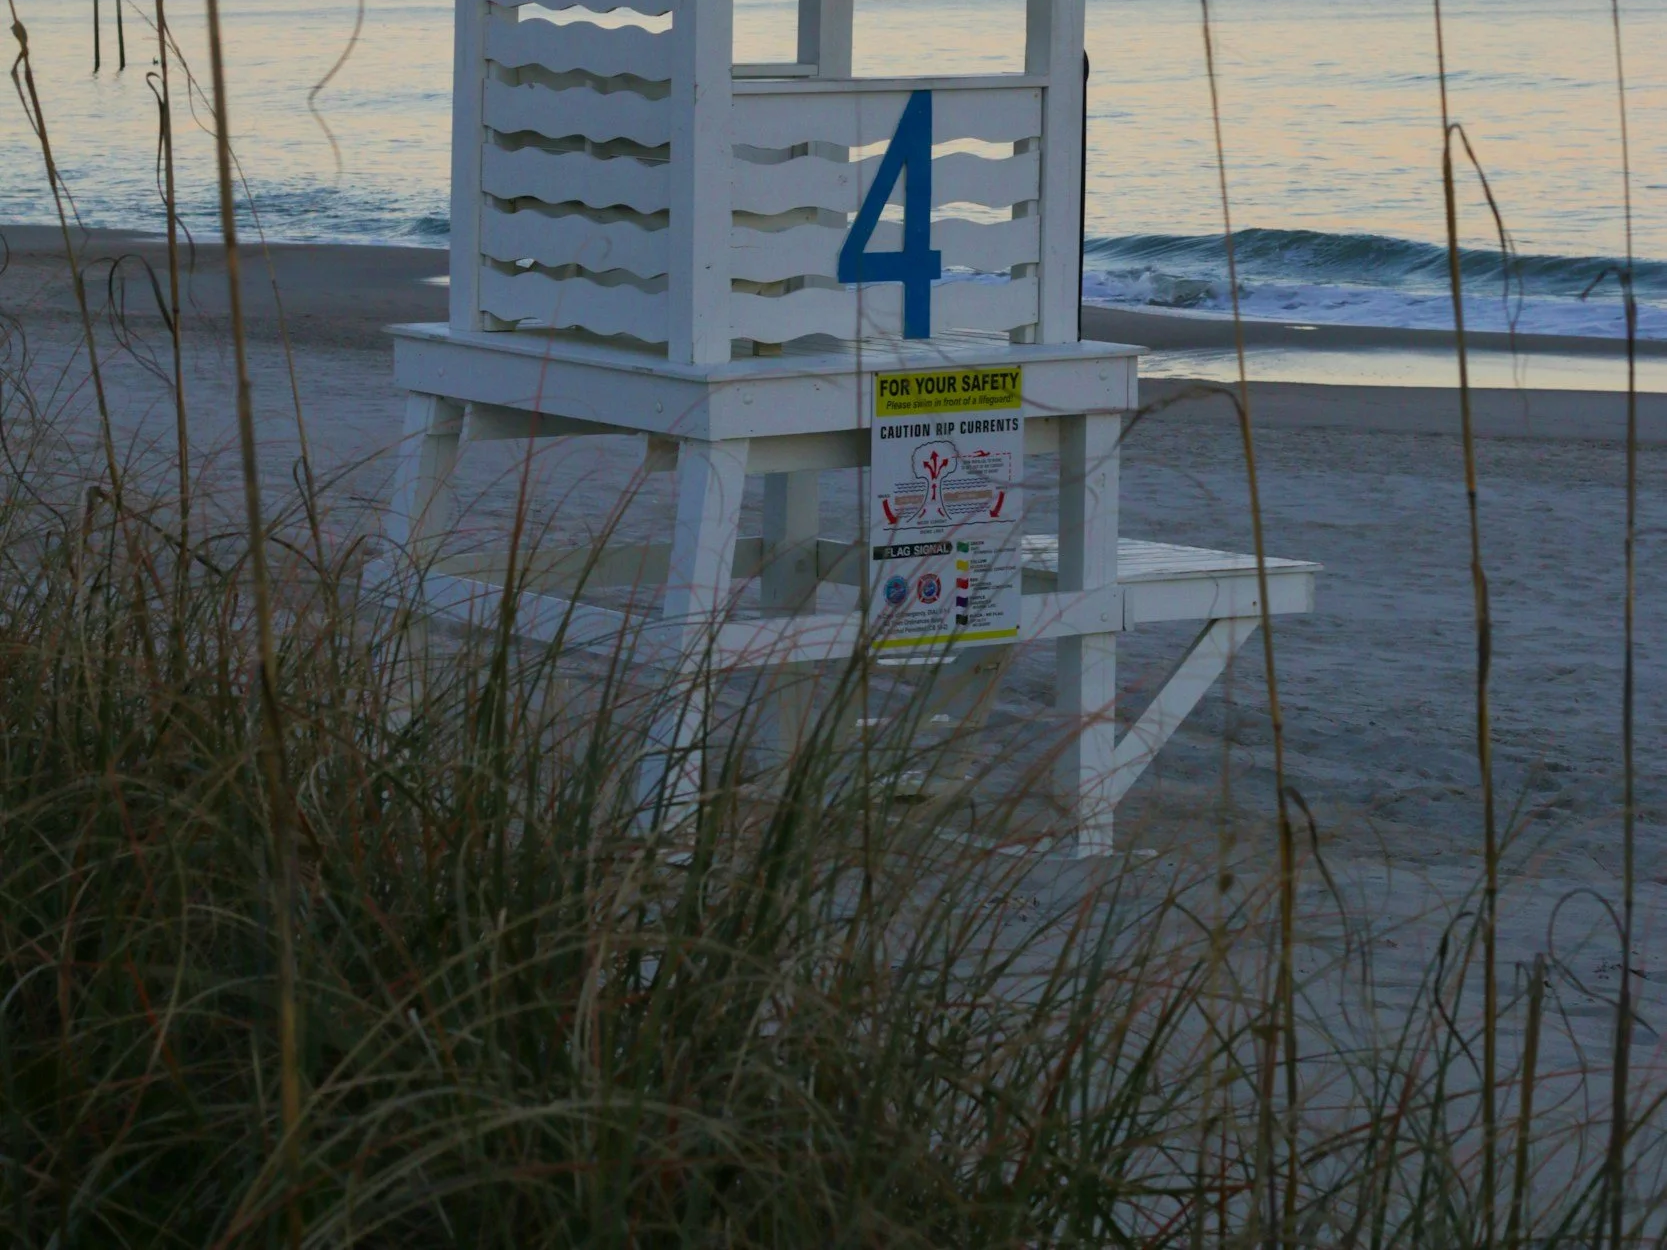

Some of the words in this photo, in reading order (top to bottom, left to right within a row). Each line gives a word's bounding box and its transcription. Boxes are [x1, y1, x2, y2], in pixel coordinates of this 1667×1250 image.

[838, 89, 942, 340] 4
[880, 378, 911, 397] FOR
[915, 376, 957, 394] YOUR
[961, 372, 1020, 392] SAFETY
[886, 400, 911, 410] Please
[913, 400, 933, 409] swim
[934, 399, 942, 408] in
[943, 397, 961, 408] front
[962, 396, 971, 406] of
[880, 423, 931, 440] CAUTION
[936, 421, 955, 436] RIP
[960, 417, 1019, 435] CURRENTS
[884, 546, 911, 558] FLAG
[913, 543, 949, 556] SIGNAL
